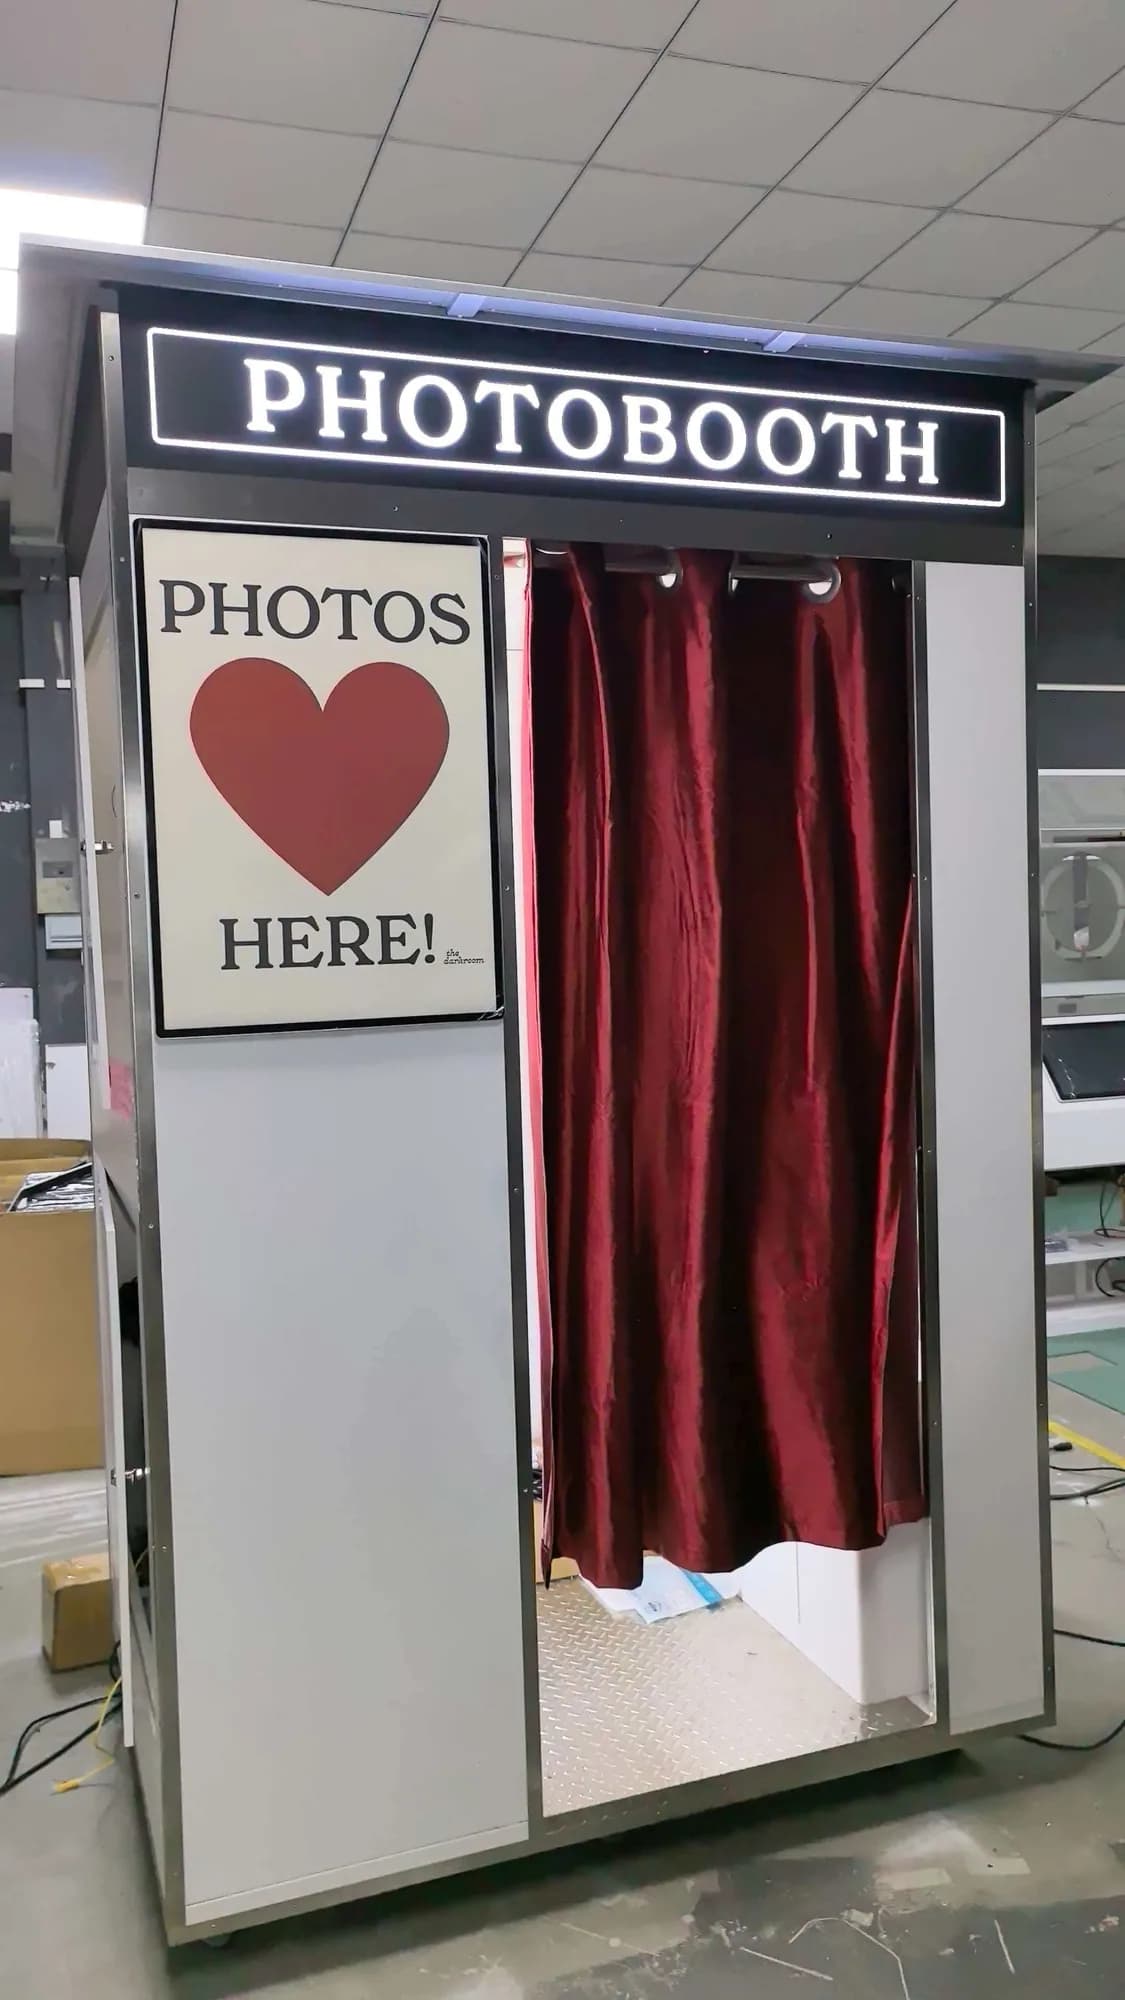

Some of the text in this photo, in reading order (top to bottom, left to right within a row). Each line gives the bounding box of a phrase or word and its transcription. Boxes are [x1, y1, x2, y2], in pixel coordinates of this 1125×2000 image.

[243, 356, 940, 485] PHOTOBOOTH
[159, 579, 471, 645] PHOTOS
[219, 912, 436, 970] HERE!
[444, 957, 485, 965] darkroom
[446, 948, 460, 956] the
